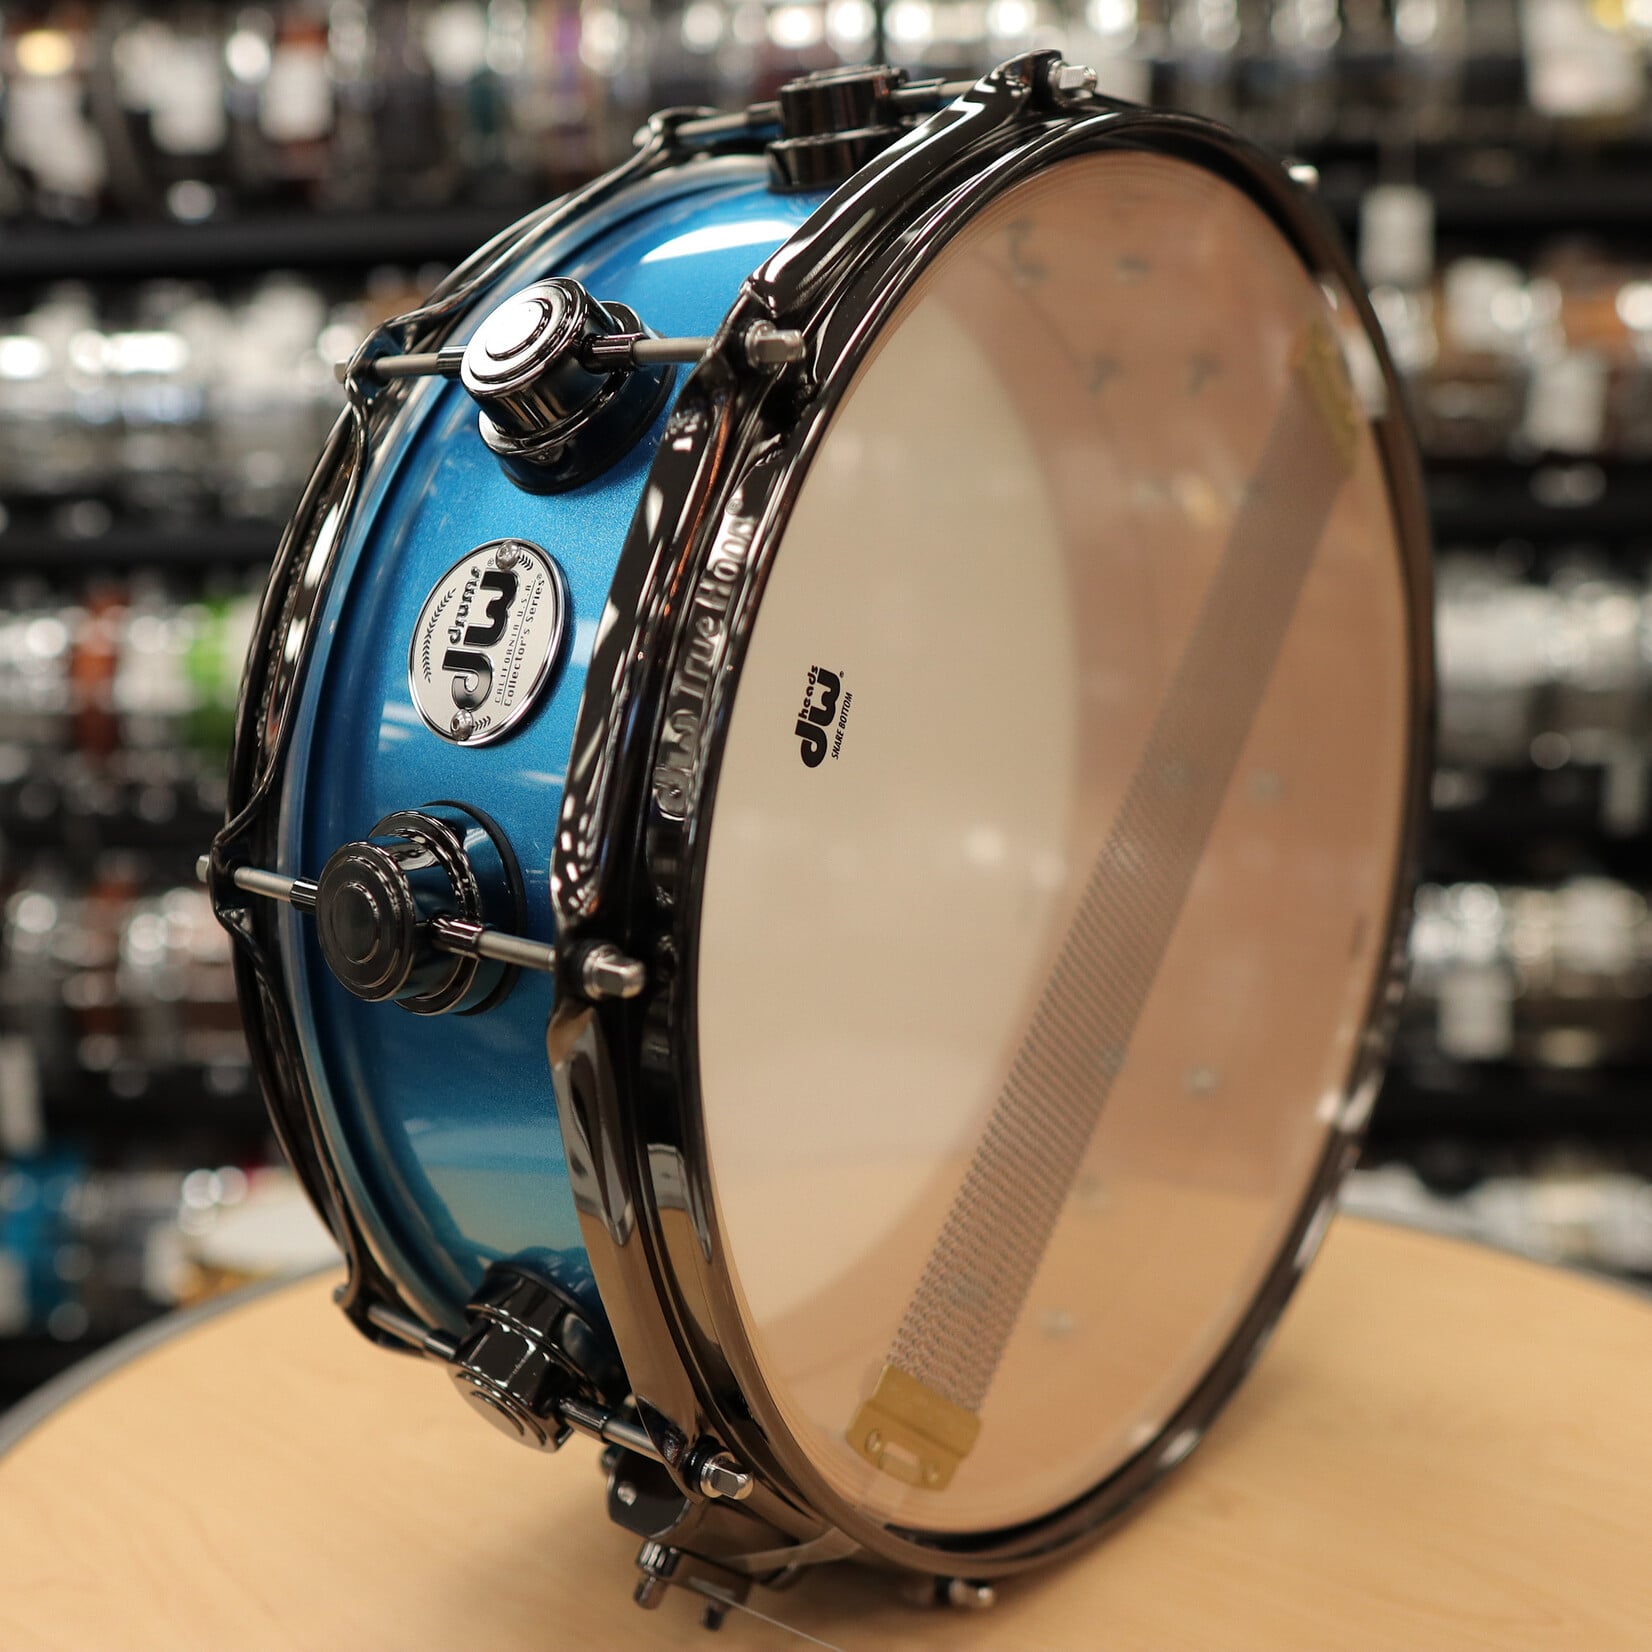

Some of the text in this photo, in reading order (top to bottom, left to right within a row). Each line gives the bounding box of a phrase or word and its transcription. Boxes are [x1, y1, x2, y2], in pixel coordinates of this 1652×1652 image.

[447, 565, 481, 645] drums
[494, 624, 520, 704] CALIFORNIA
[504, 627, 530, 708] Collector's
[798, 665, 819, 720] heads
[831, 691, 853, 761] SNARE BOTTOM
